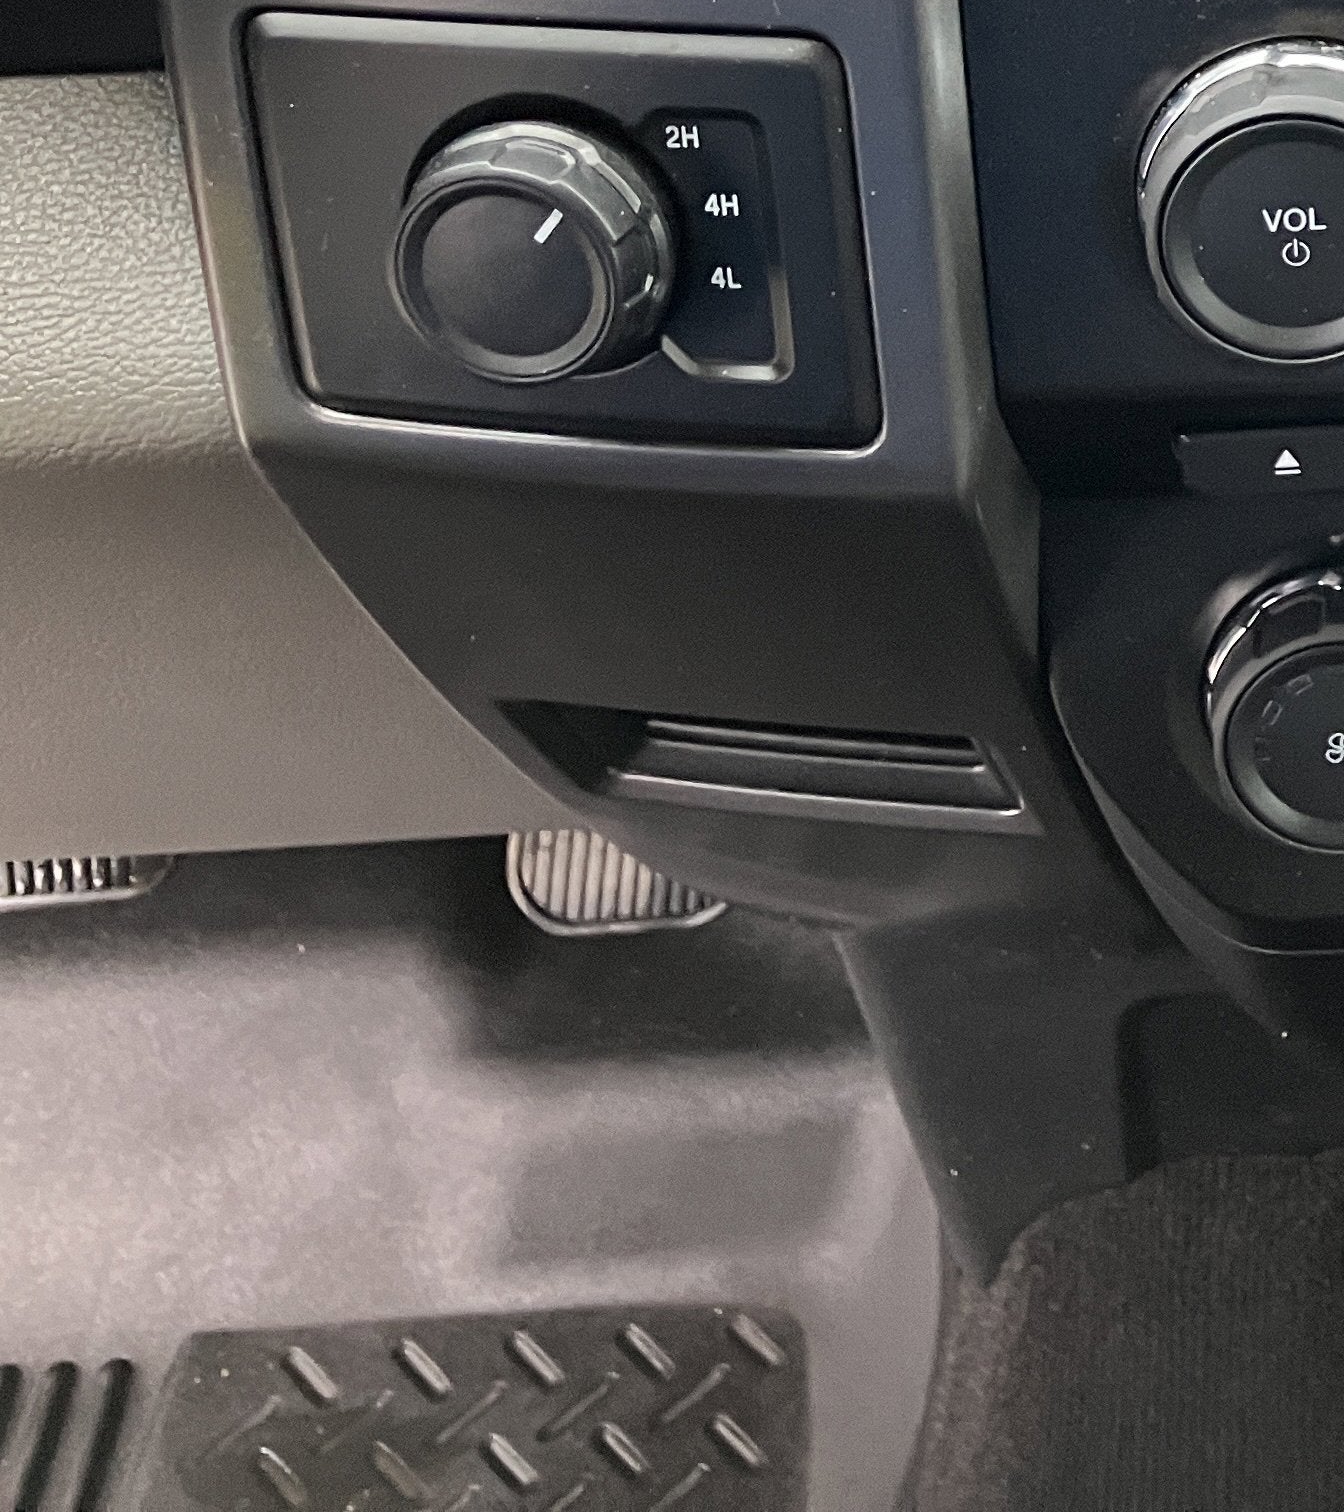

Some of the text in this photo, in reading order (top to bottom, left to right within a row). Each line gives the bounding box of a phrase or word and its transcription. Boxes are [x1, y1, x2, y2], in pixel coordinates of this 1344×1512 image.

[665, 125, 700, 149] 2H
[704, 193, 740, 217] 4H
[1261, 207, 1328, 232] VOL
[710, 266, 742, 289] 4L
